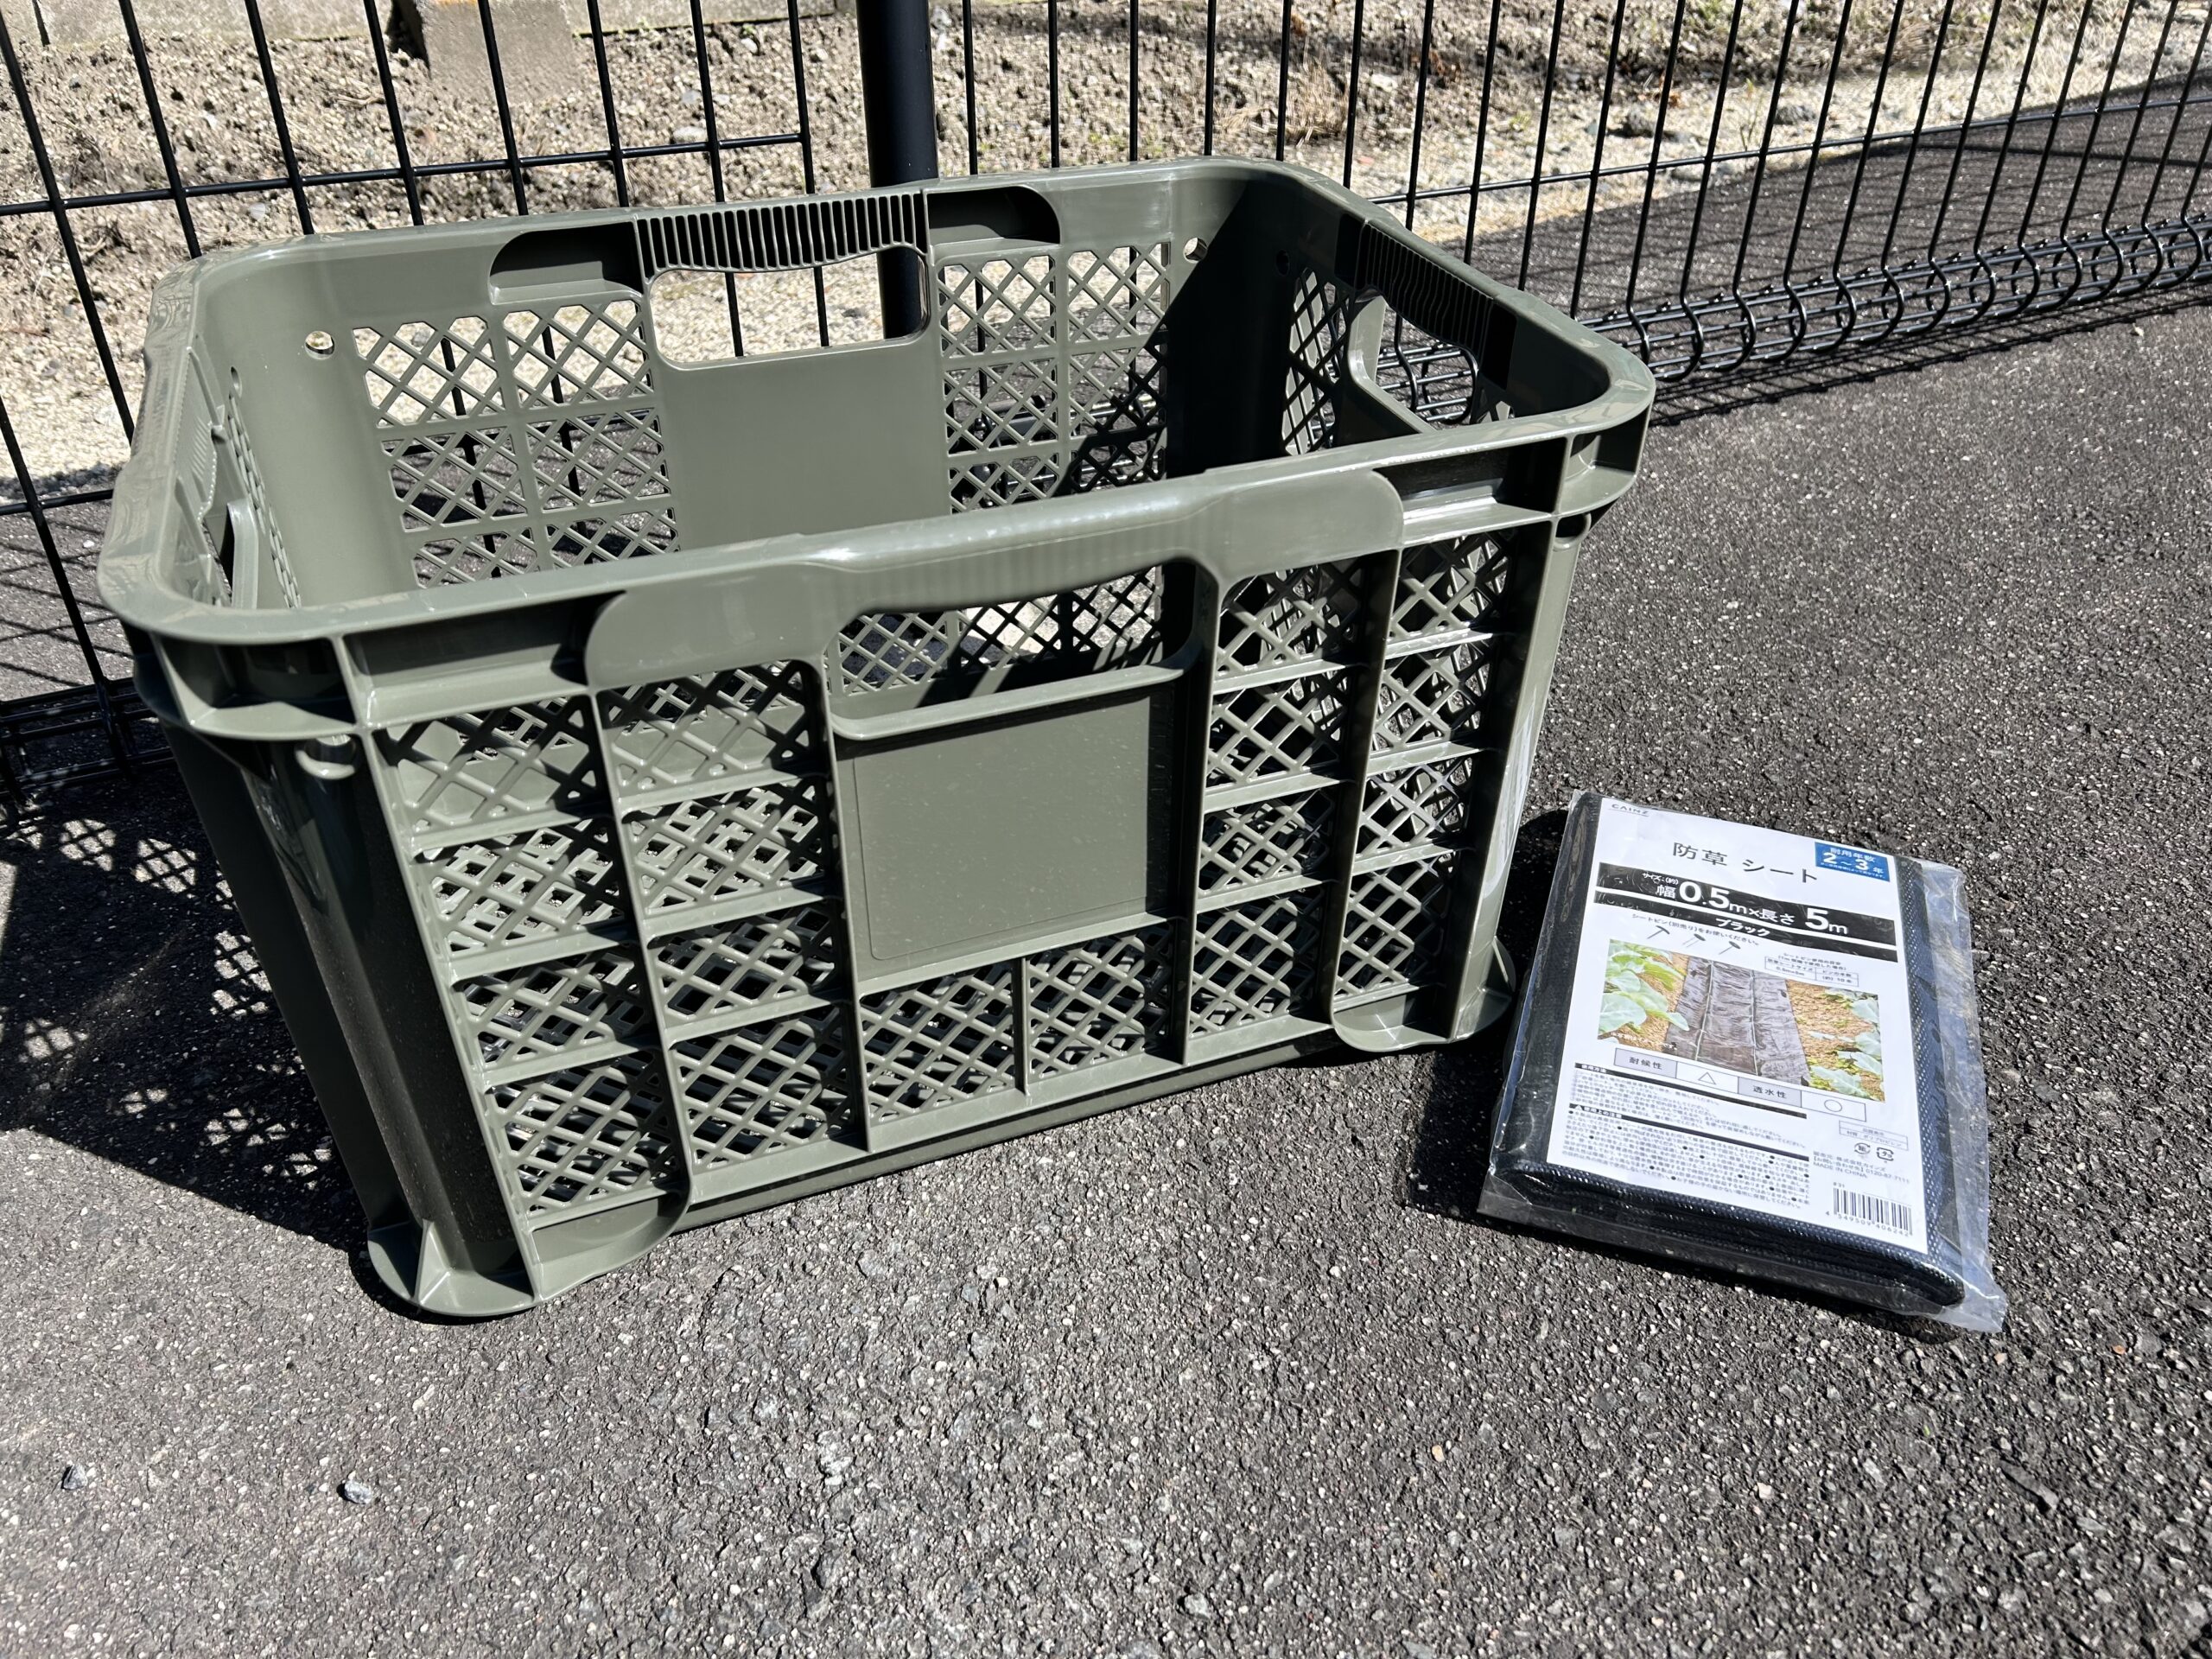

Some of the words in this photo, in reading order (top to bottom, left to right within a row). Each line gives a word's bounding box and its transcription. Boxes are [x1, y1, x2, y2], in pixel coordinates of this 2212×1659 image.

[1611, 804, 1649, 815] CAINZ
[1830, 848, 1876, 862] 耐用年数
[1673, 842, 1727, 865] 防草
[1742, 859, 1817, 883] シート
[1715, 918, 1770, 937] ブラック
[1629, 1056, 1662, 1070] 耐候性
[1752, 1085, 1787, 1098] 透水性
